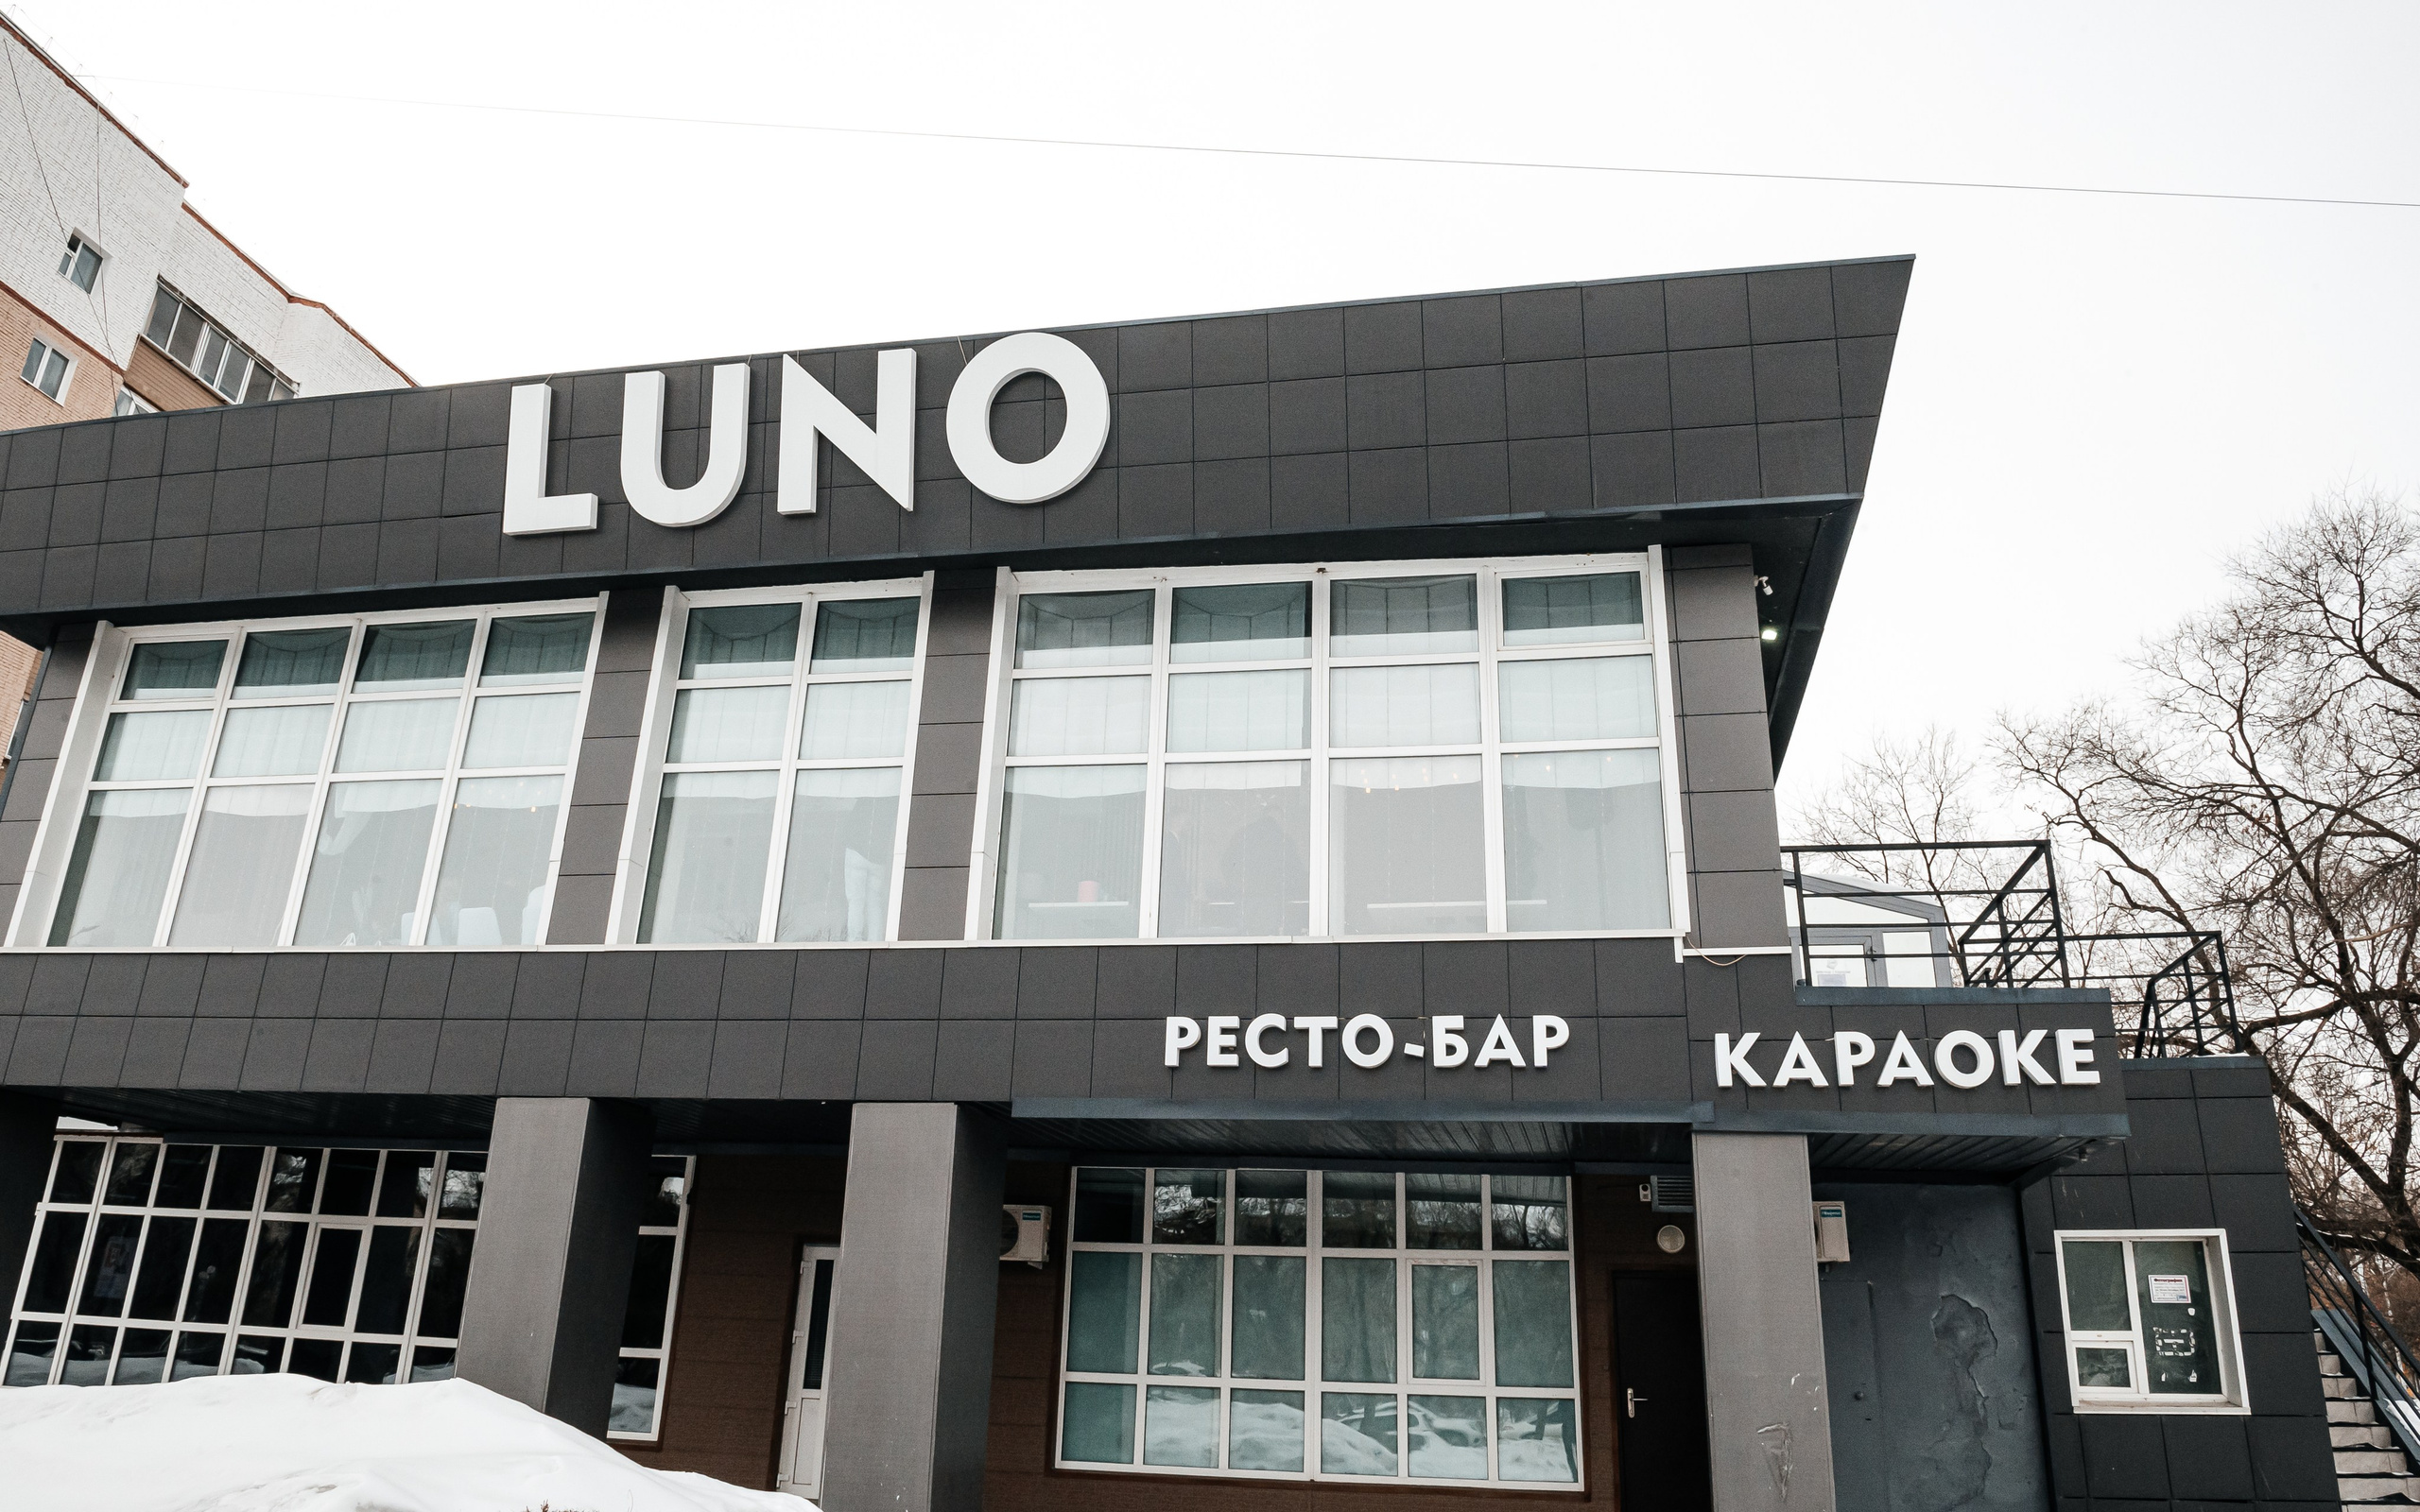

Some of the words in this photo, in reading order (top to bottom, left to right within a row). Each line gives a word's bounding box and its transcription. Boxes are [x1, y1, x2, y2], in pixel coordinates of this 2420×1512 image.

[503, 332, 1110, 536] LUNO
[1164, 1013, 1570, 1069] РЕСТО-БАР
[1714, 1028, 2100, 1090] КАРАОКЕ
